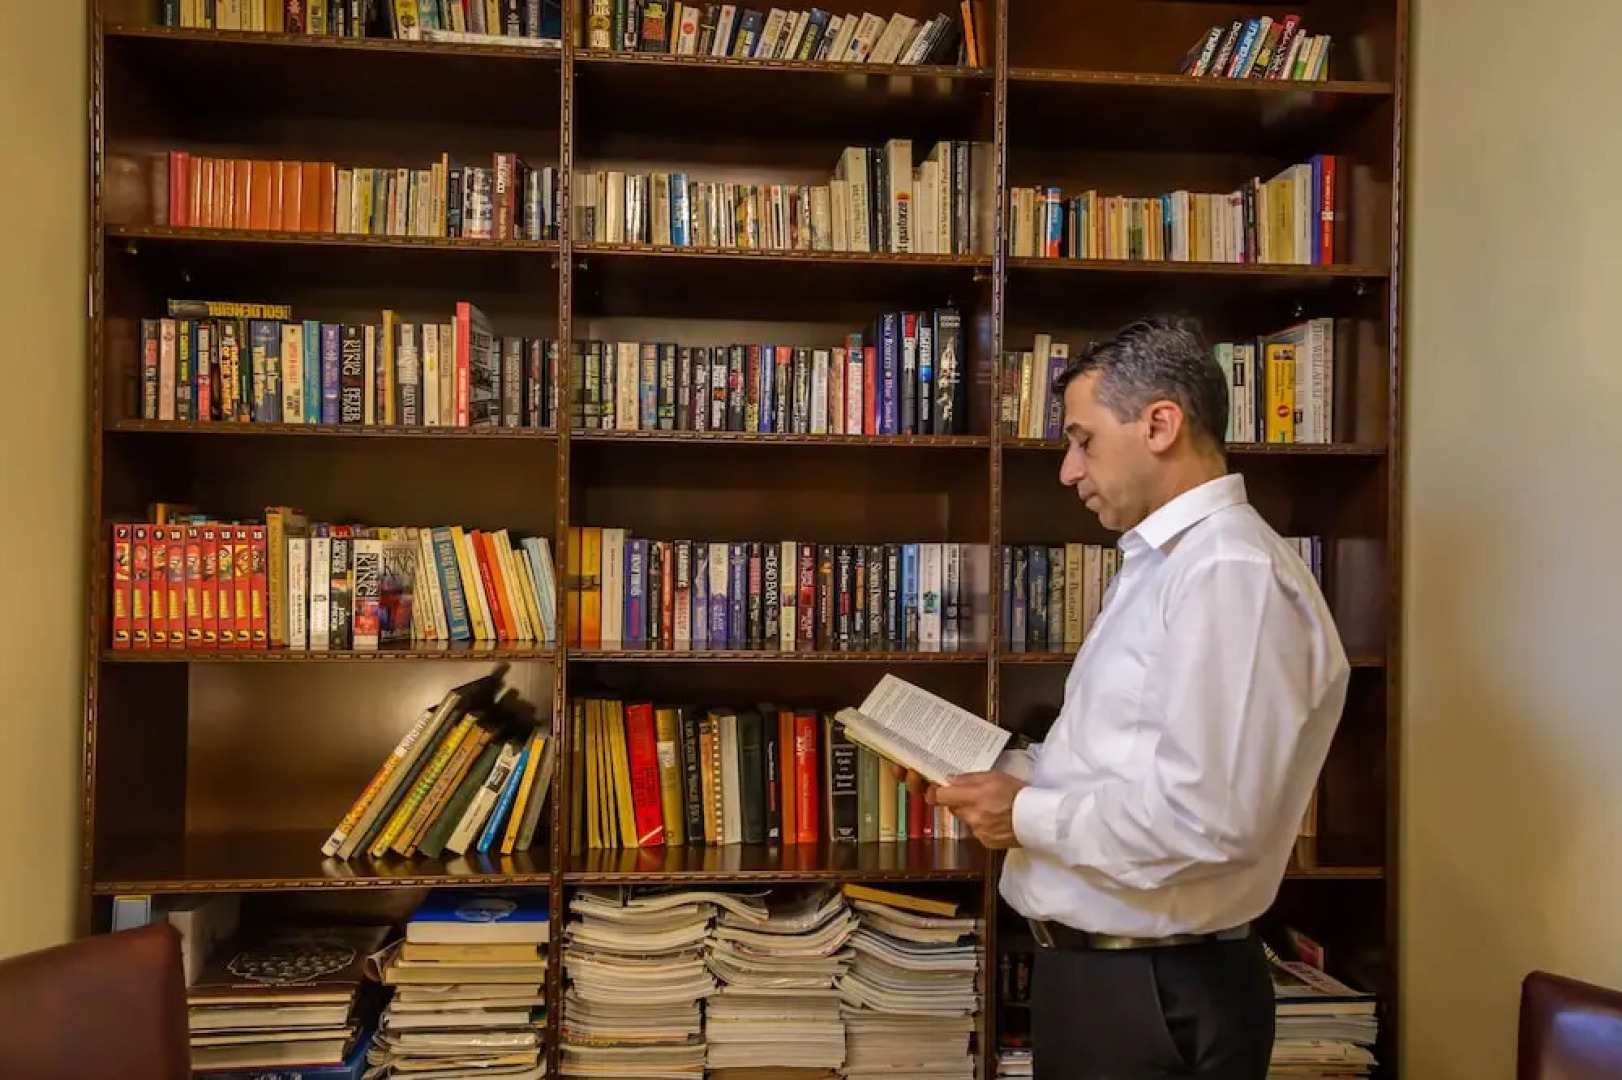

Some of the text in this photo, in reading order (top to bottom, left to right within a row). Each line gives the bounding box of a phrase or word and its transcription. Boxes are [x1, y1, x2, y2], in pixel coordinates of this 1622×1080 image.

[343, 339, 353, 376] KING
[119, 529, 127, 538] 7
[171, 531, 181, 540] 10
[236, 531, 246, 539] 14
[356, 556, 370, 597] KING
[369, 554, 379, 597] STEPHEN
